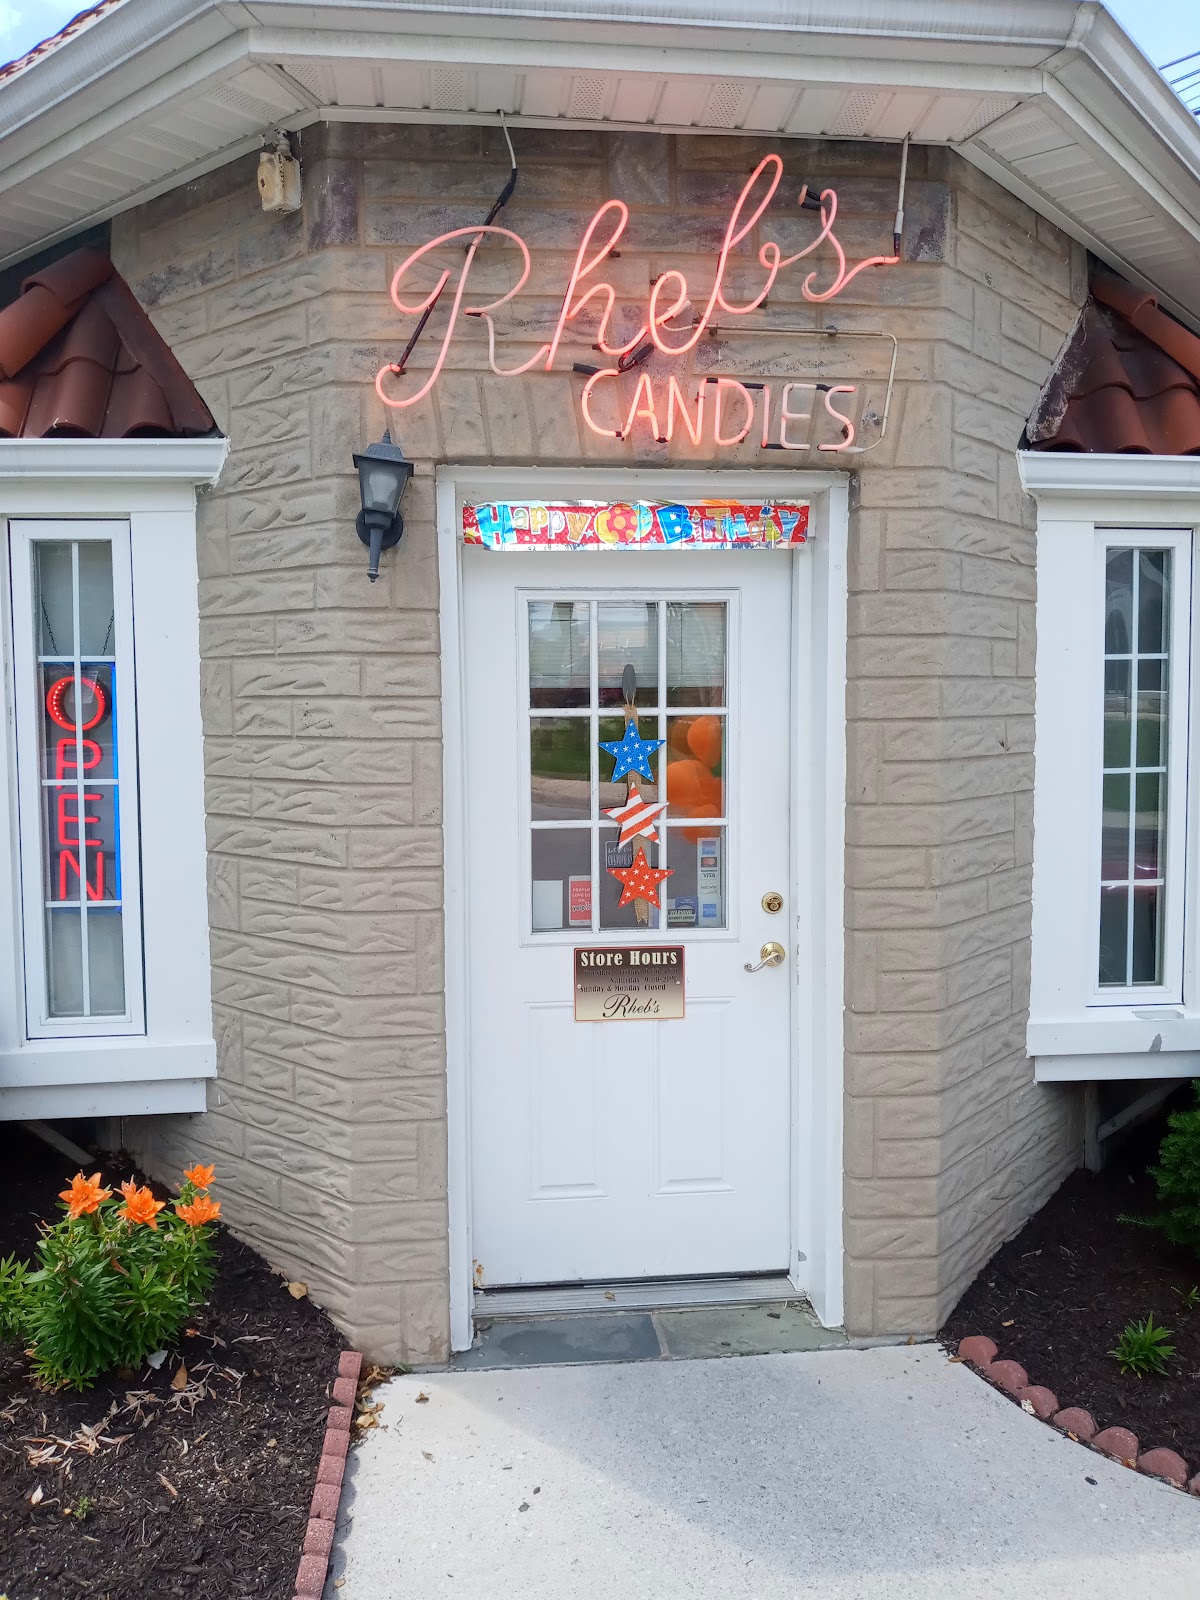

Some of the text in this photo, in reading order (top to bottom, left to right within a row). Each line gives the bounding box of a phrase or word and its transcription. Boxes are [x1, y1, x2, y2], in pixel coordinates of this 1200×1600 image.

[581, 368, 856, 451] CANDIES
[46, 676, 105, 902] OPEN
[580, 950, 677, 966] Store Hours
[580, 983, 666, 993] Sunday & Monday Closed
[610, 977, 640, 985] Saturday
[602, 993, 660, 1018] Rheb's
